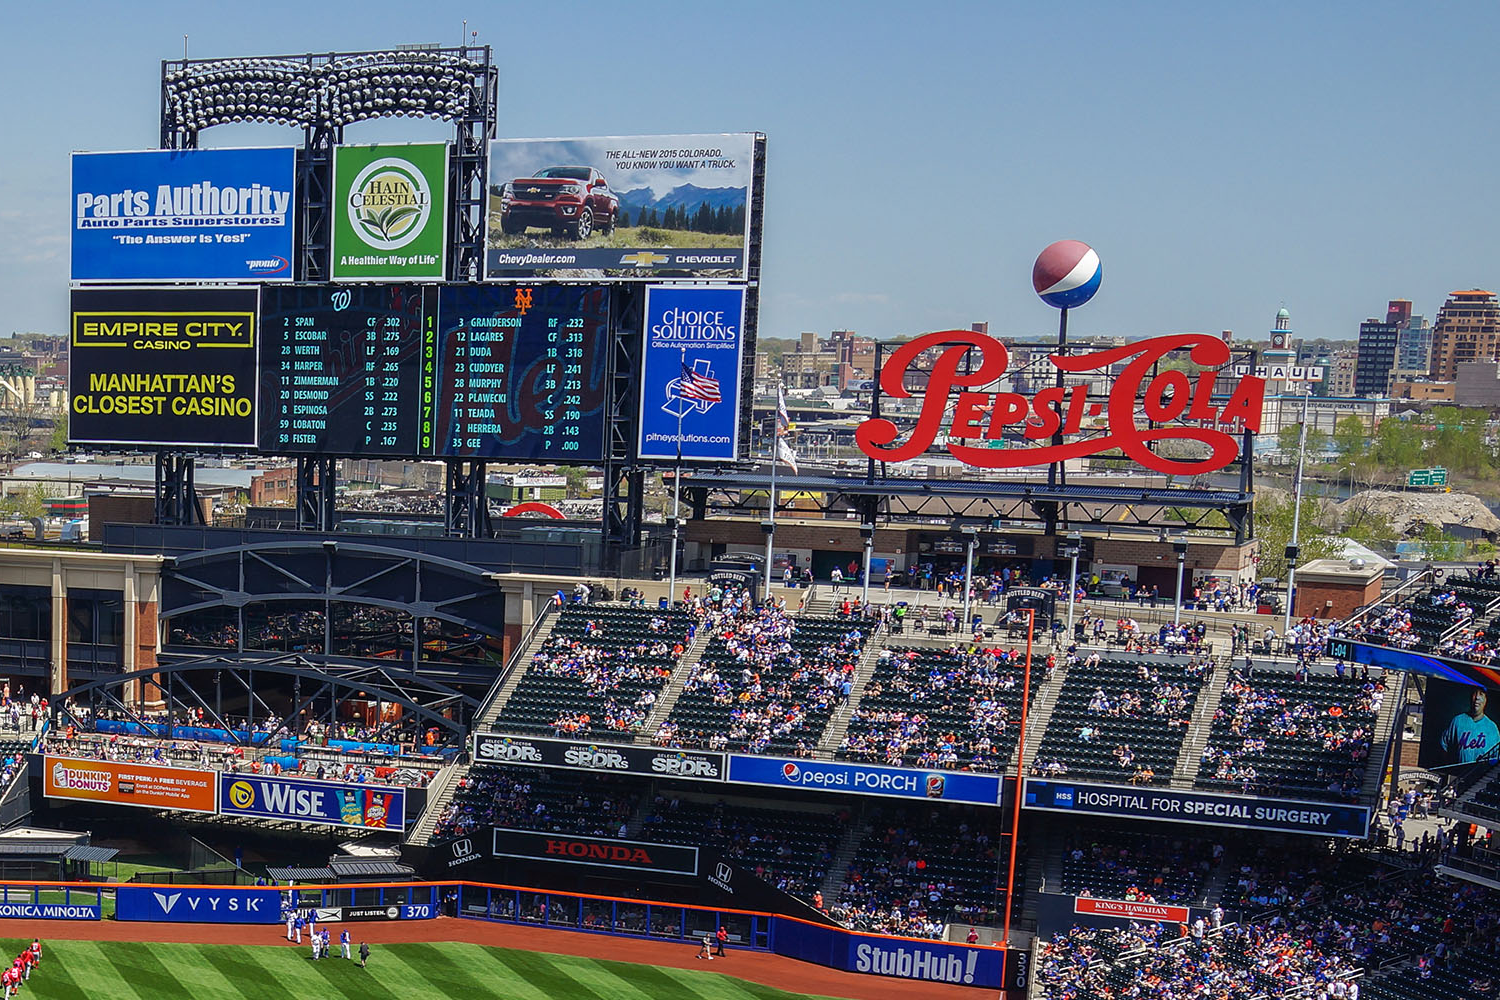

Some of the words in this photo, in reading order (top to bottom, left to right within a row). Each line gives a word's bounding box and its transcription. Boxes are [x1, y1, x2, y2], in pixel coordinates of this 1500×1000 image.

[606, 150, 620, 159] THE
[621, 150, 658, 158] ALL-NEW
[660, 150, 677, 158] 2015
[679, 149, 722, 158] COLORADO.
[616, 162, 632, 170] YOU
[632, 161, 658, 169] KNOW
[676, 160, 700, 168] WANT
[700, 160, 706, 168] A
[708, 160, 736, 168] TRUCK.
[369, 181, 410, 194] HAIN
[77, 189, 150, 218] Parts
[155, 181, 290, 215] Authority
[350, 192, 428, 208] CELESTIAL
[81, 219, 119, 228] Auto
[124, 218, 168, 227] Parts
[172, 216, 281, 227] Superstores
[146, 234, 197, 244] Answer
[199, 234, 212, 243] Is
[341, 256, 347, 265] A
[348, 255, 388, 265] Healthier
[389, 255, 407, 266] Way
[408, 255, 418, 265] of
[499, 253, 576, 266] ChevyDealer.com
[676, 255, 737, 264] CHEVROLET
[284, 318, 288, 326] 2
[295, 318, 314, 326] SPAN
[367, 318, 376, 326] CF
[384, 318, 400, 326] .302
[458, 318, 464, 327] 3
[470, 318, 522, 327] GRANDERSON
[548, 319, 558, 327] RF
[567, 319, 584, 327] .232
[83, 322, 178, 336] EMPIRE
[652, 325, 736, 340] SOLUTIONS
[284, 332, 288, 340] 5
[295, 332, 326, 340] ESCOBAR
[366, 332, 376, 340] 3B
[384, 332, 400, 340] .275
[456, 333, 466, 341] 12
[470, 332, 504, 342] LAGARES
[548, 334, 557, 342] CF
[566, 334, 582, 342] .313
[133, 340, 191, 350] CASINO
[282, 346, 290, 354] 28
[295, 346, 320, 354] WERTH
[366, 347, 375, 355] LF
[383, 347, 399, 356] .169
[456, 348, 464, 356] 21
[470, 348, 491, 356] DUDA
[547, 349, 556, 357] 1B
[566, 349, 582, 358] .318
[89, 373, 235, 394] MANHATTAN'S
[73, 395, 167, 415] CLOSEST
[171, 396, 252, 417] CASINO
[1331, 642, 1347, 658] 1:04
[1459, 732, 1487, 749] Mets
[69, 769, 111, 782] DUNKIN'
[802, 770, 848, 788] pepsi
[854, 773, 917, 792] PORCH
[68, 779, 110, 792] DONUTS
[1055, 792, 1072, 800] HSS
[1077, 792, 1148, 810] HOSPITAL
[1151, 797, 1181, 813] FOR
[1183, 801, 1251, 820] SPECIAL
[1254, 807, 1332, 826] SURGERY
[545, 840, 653, 864] HONDA
[448, 852, 482, 868] HONDA
[707, 874, 734, 895] HONDA
[187, 897, 260, 912] VYSK
[1095, 902, 1123, 911] KING'S
[1124, 904, 1168, 914] HAWAIIAN
[43, 906, 95, 918] MINOLTA
[407, 906, 429, 917] 370
[856, 943, 979, 985] StubHub!
[1016, 952, 1026, 988] 330
